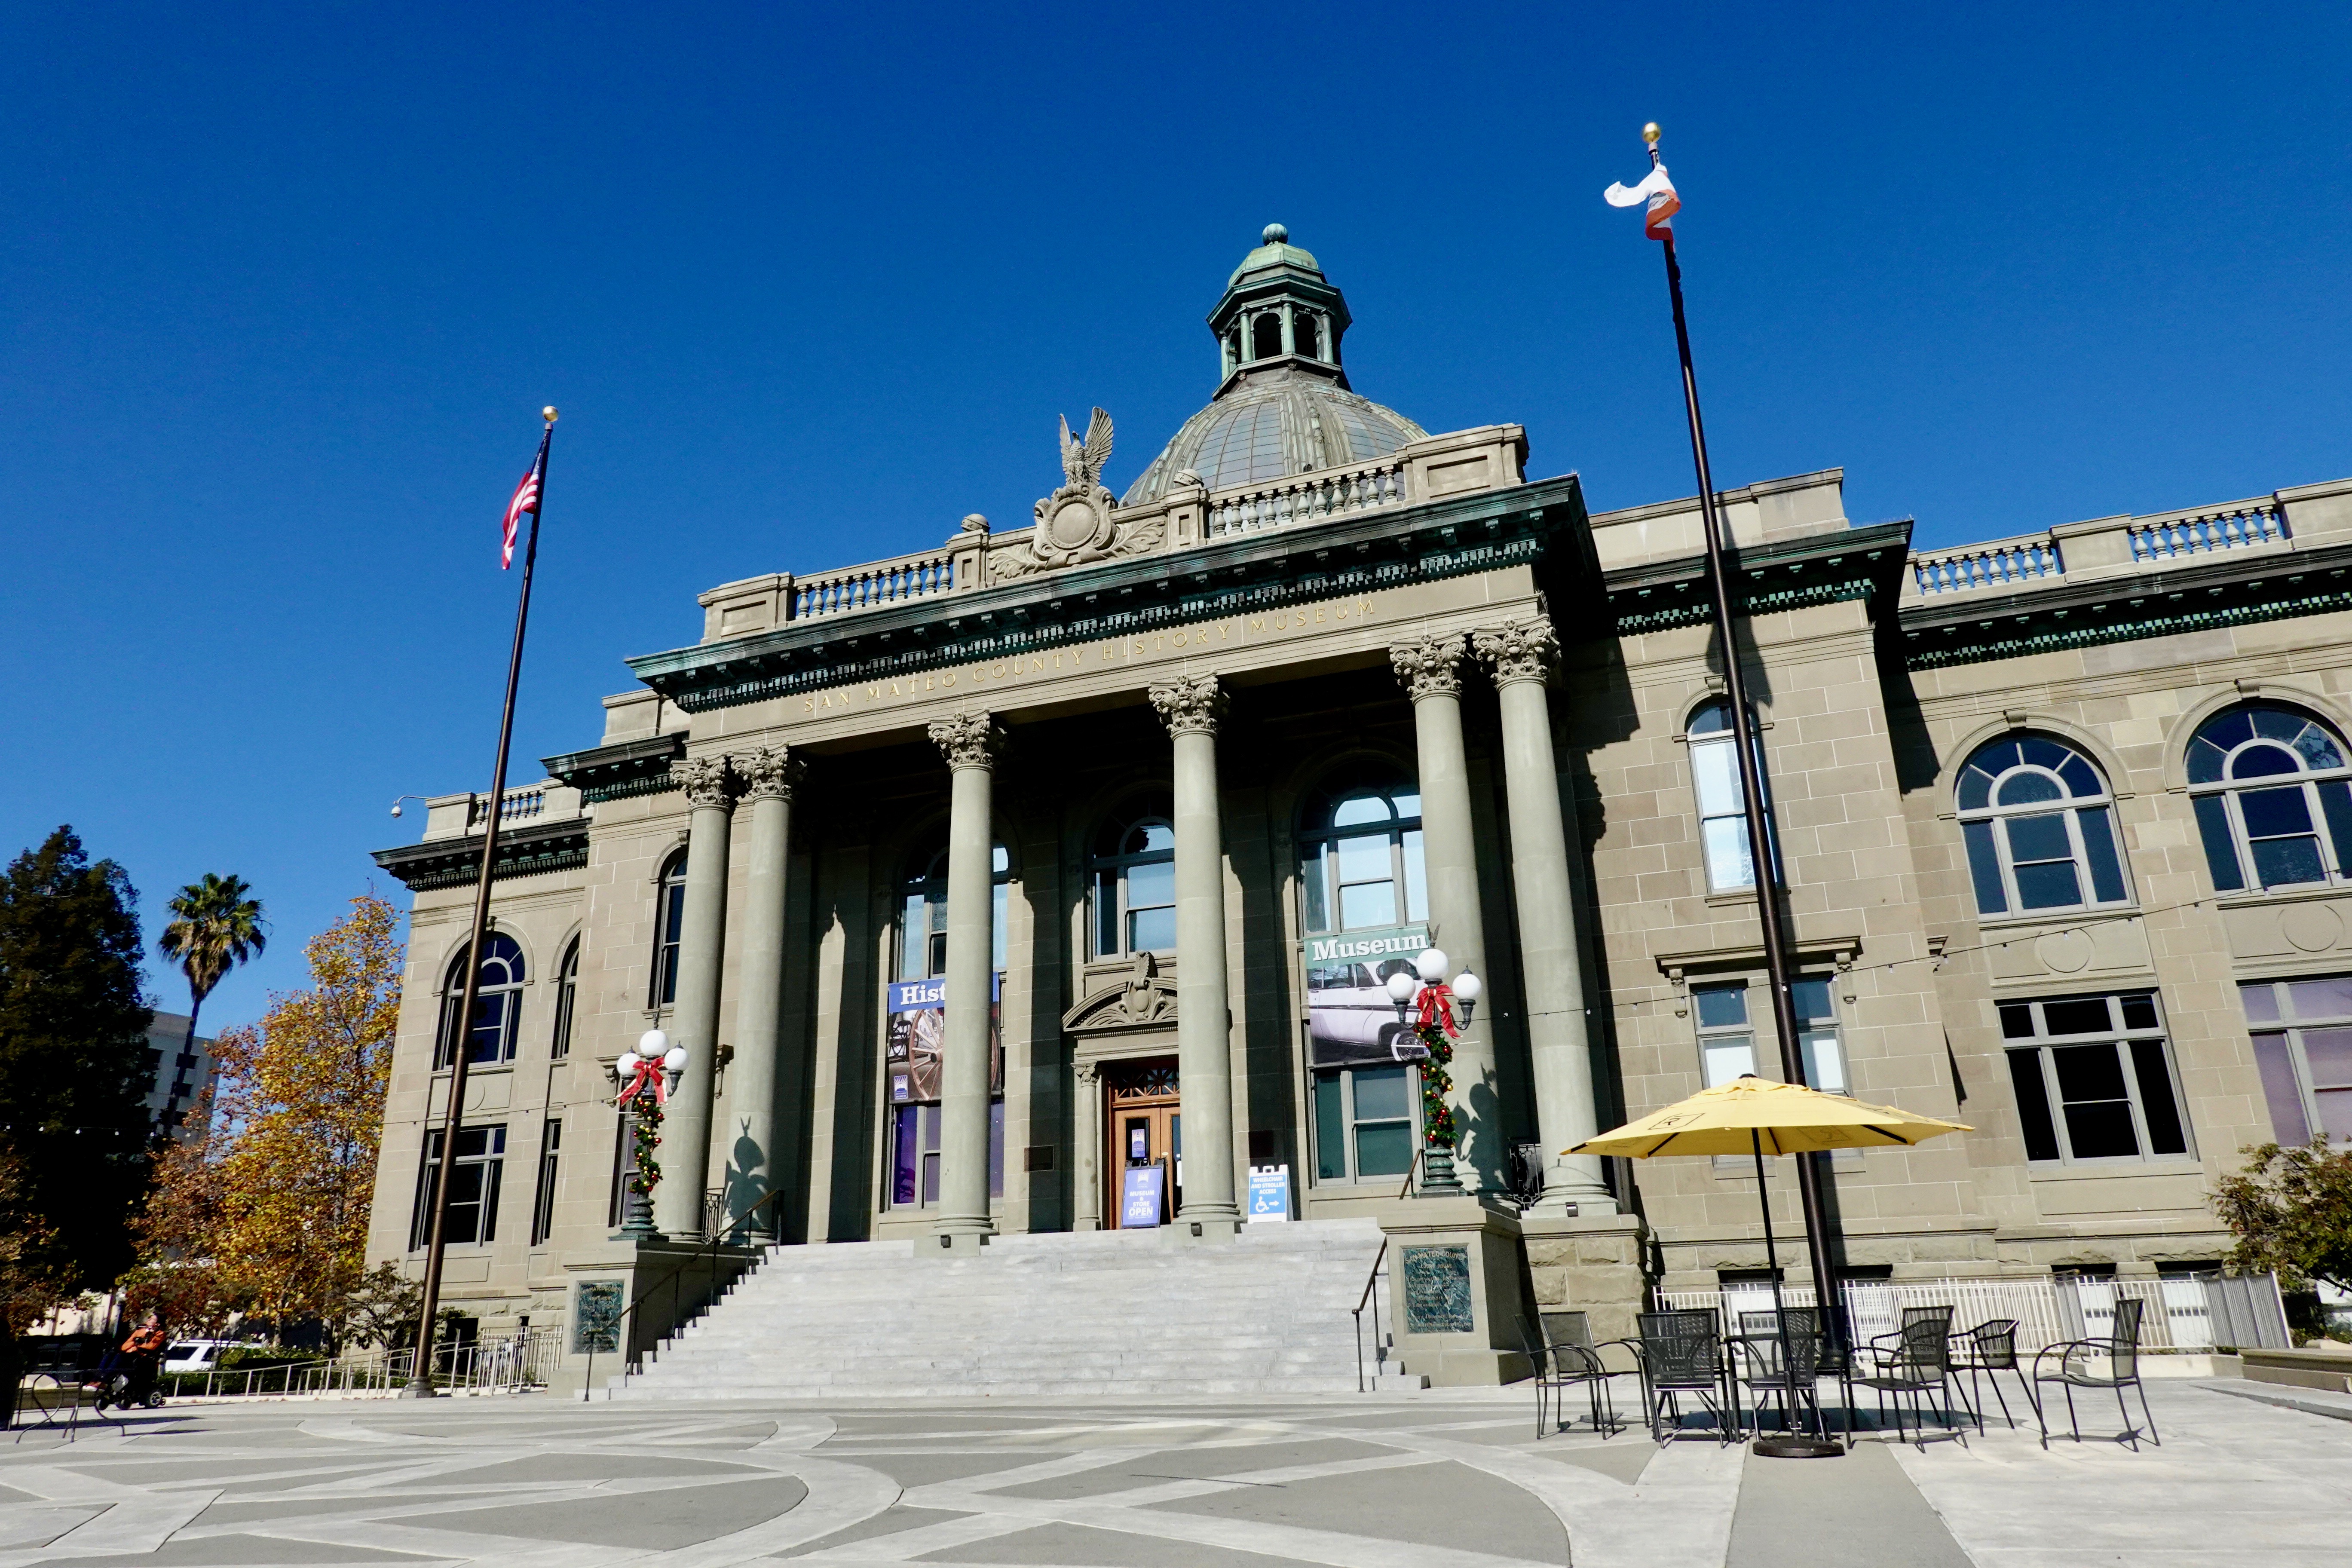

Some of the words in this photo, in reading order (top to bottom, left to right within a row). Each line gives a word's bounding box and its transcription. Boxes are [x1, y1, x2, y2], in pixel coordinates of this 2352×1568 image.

[805, 691, 850, 712] SAN
[866, 673, 956, 701] MATEO
[973, 650, 1084, 682] COUNTY
[1102, 624, 1230, 660] HISTORY
[1250, 599, 1375, 634] MUSEUM
[1312, 934, 1428, 961] Museum
[900, 983, 946, 1005] Hist
[1128, 1207, 1153, 1216] OPEN
